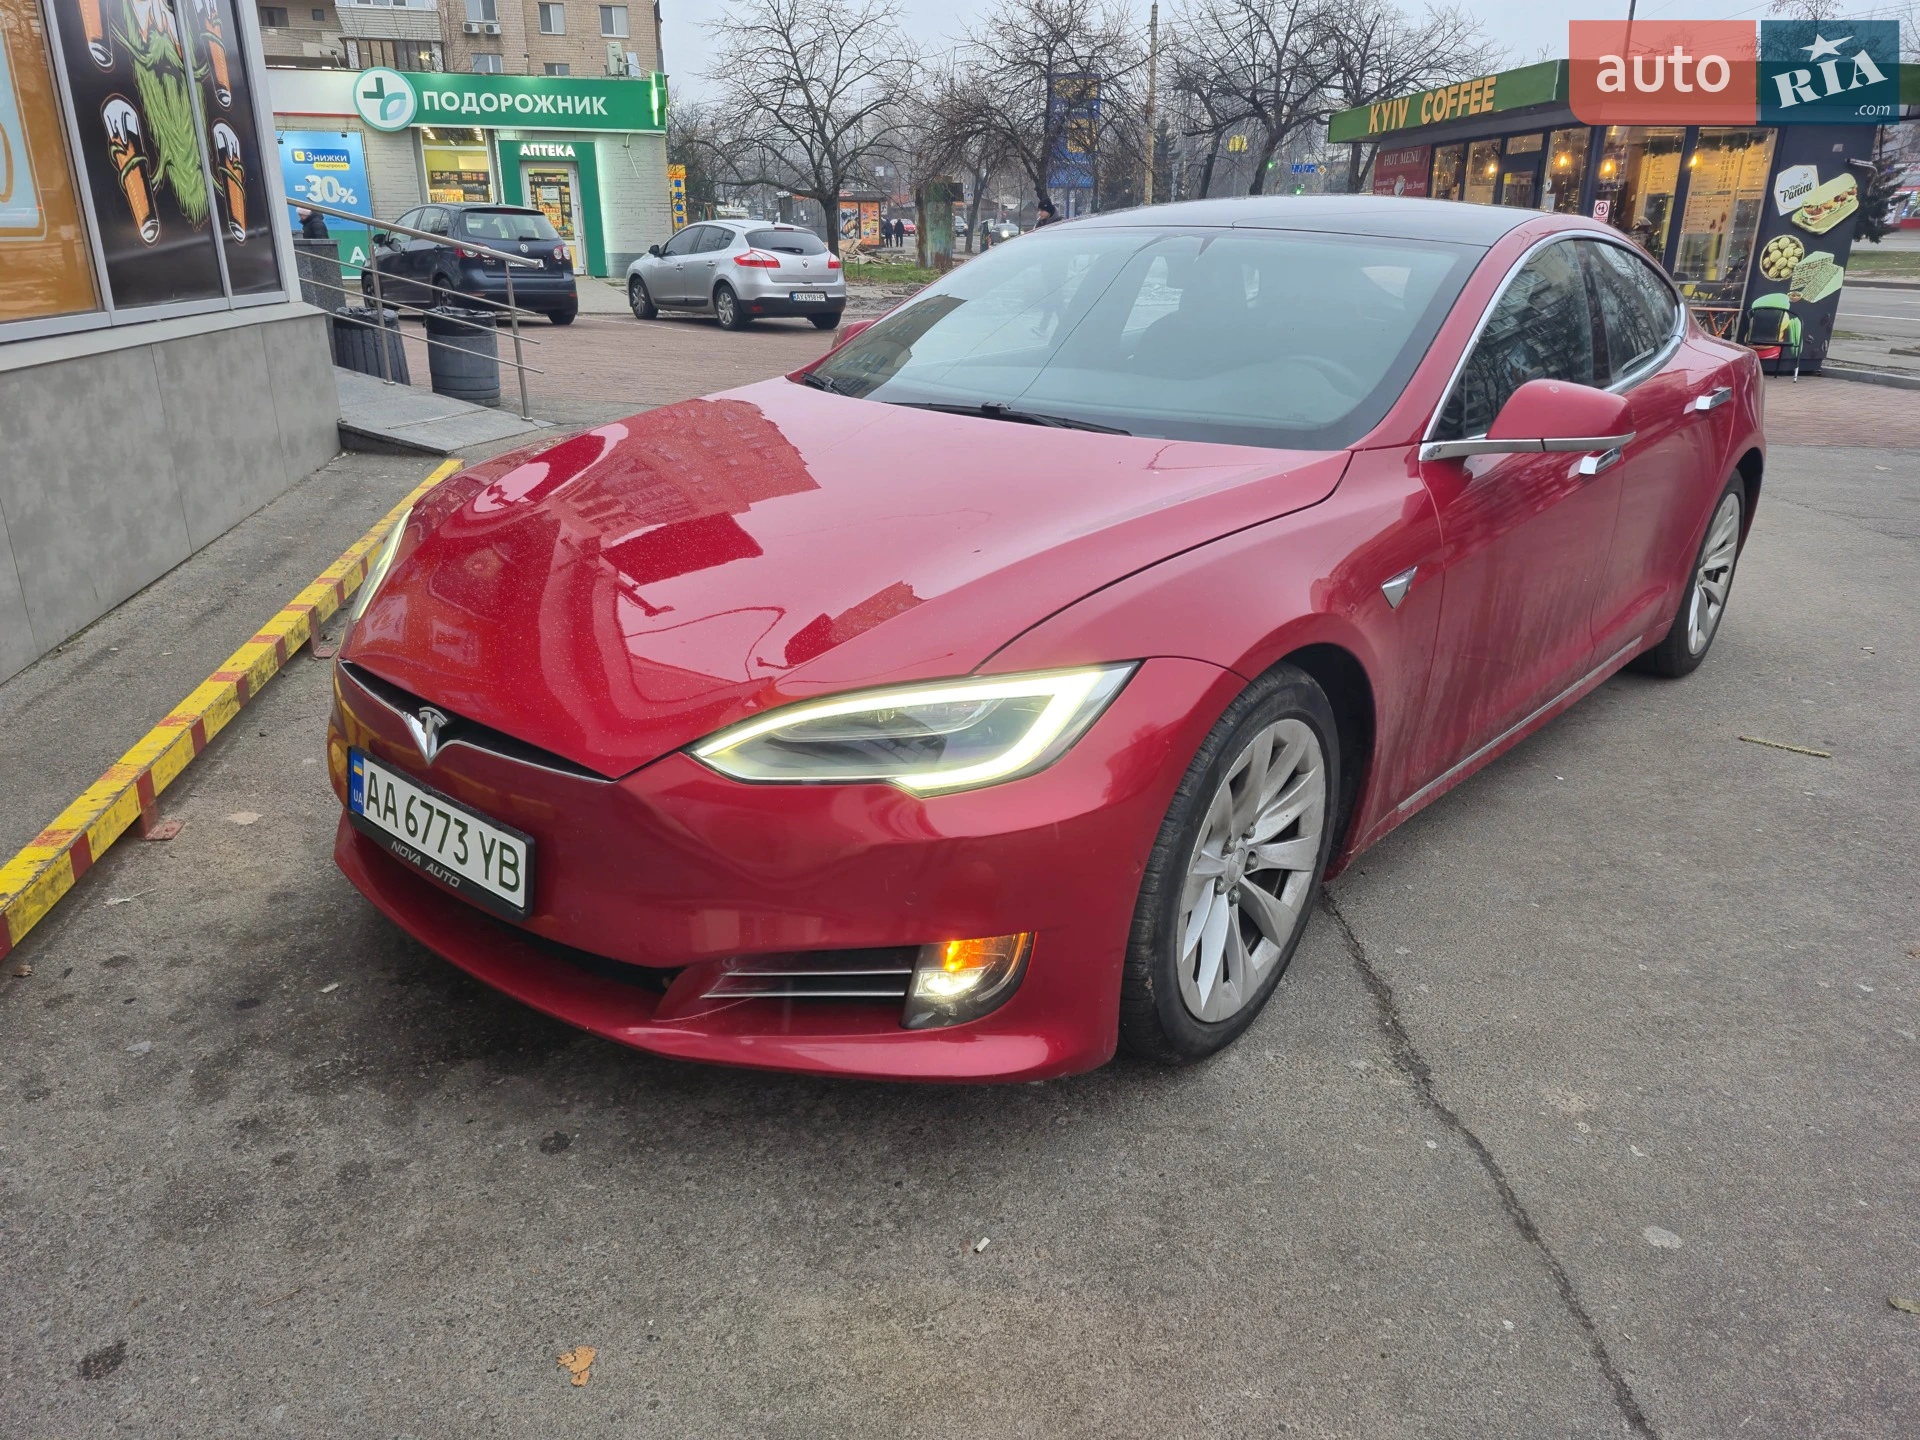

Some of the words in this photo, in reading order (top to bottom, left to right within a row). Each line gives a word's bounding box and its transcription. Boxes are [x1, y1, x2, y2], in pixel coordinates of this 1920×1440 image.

[422, 91, 609, 116] ПОДОРОЖНИК
[1368, 97, 1411, 134] KYIV
[1421, 75, 1497, 125] COFFEE
[306, 151, 347, 162] Знижки
[519, 144, 576, 157] АПТЕКА
[1384, 153, 1398, 166] HOT
[1400, 150, 1421, 164] MENU
[353, 788, 363, 806] UA
[366, 771, 399, 829] AA
[405, 795, 469, 866] 6773
[479, 831, 521, 893] YB
[391, 840, 422, 865] NOVA
[425, 863, 461, 888] AUTO
